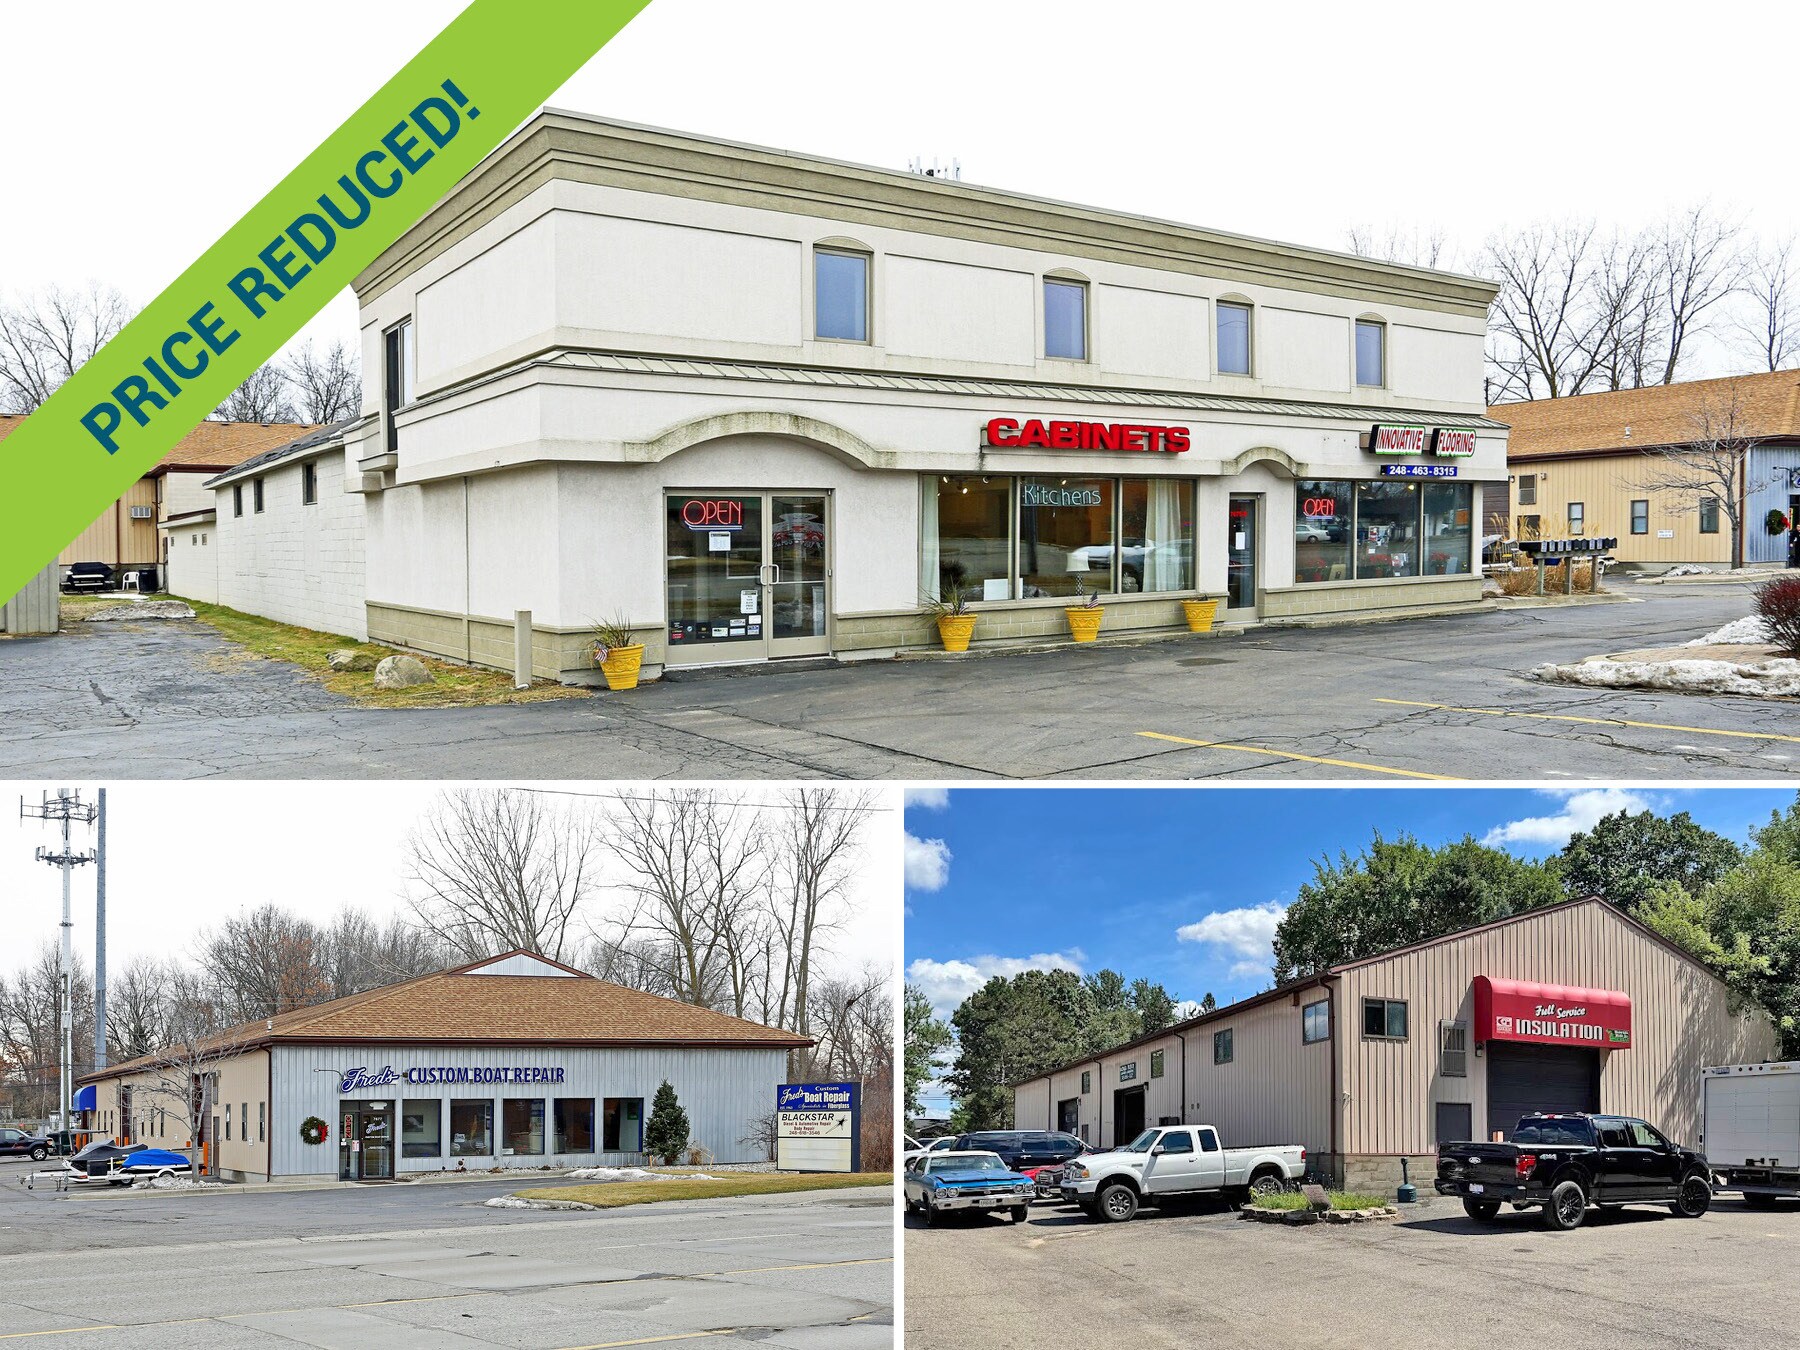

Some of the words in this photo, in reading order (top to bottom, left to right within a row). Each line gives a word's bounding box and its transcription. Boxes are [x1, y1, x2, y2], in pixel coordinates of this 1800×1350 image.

[986, 417, 1191, 453] CABINETS
[1376, 428, 1423, 450] INNOVATIVE
[1437, 431, 1475, 453] FLOORING
[1023, 484, 1102, 506] Kitchens
[683, 500, 742, 525] OPEN
[1303, 498, 1336, 517] OPEN
[1535, 1004, 1555, 1016] Full
[1556, 1006, 1586, 1019] Service
[1515, 1018, 1604, 1040] INSULATION
[408, 1067, 469, 1084] CUSTOM
[473, 1067, 511, 1084] BOAT
[513, 1067, 565, 1084] REPAIR
[804, 1092, 823, 1103] Boat
[824, 1091, 850, 1103] Repair
[781, 1113, 835, 1121] BLACKSTAR
